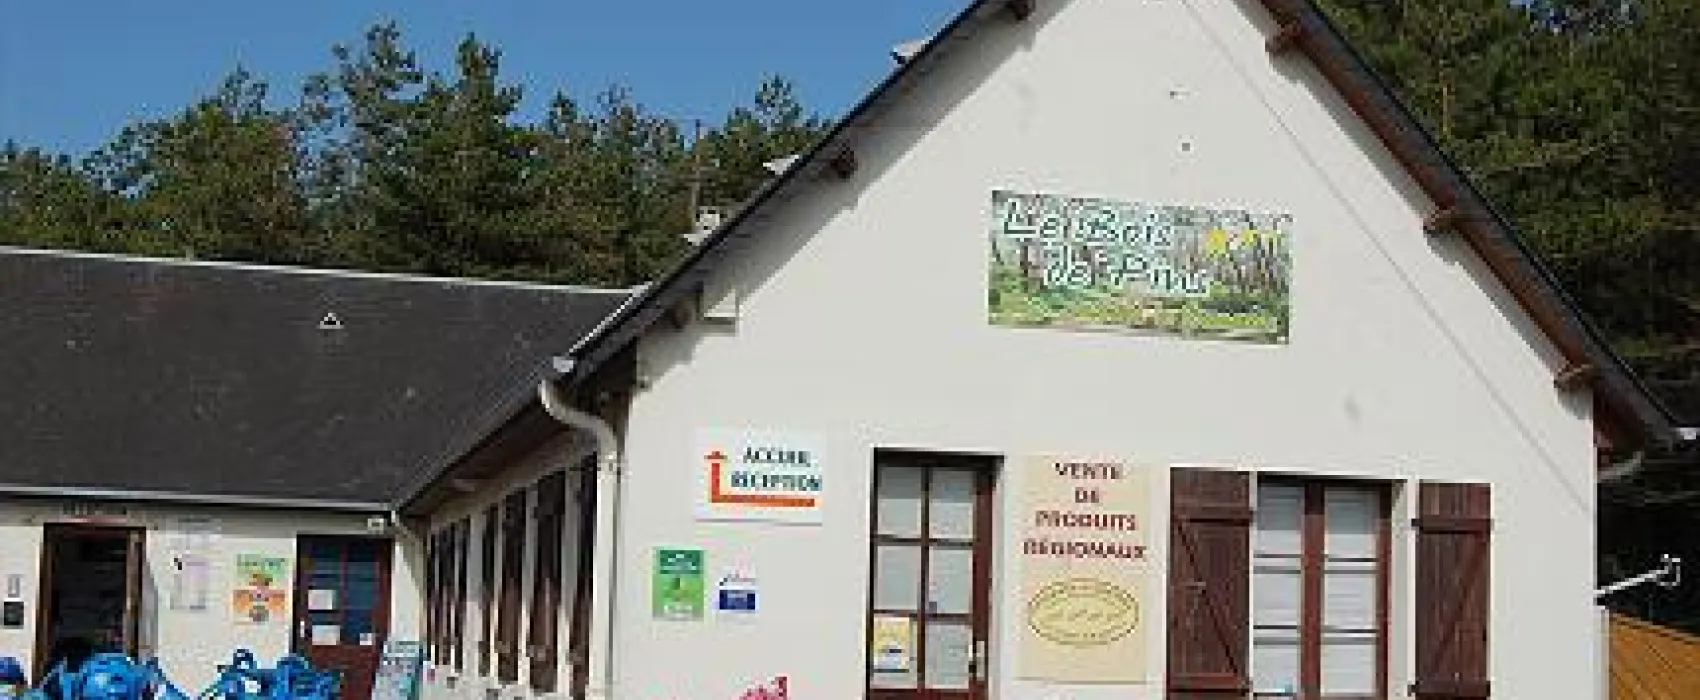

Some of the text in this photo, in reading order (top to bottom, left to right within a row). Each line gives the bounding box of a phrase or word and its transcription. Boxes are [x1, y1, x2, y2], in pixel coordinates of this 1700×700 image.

[1001, 198, 1173, 247] Le Bois
[742, 446, 812, 467] ACCUEIL
[1054, 462, 1124, 480] VENTE
[1074, 487, 1101, 504] DE
[1035, 510, 1139, 532] PRODUITS
